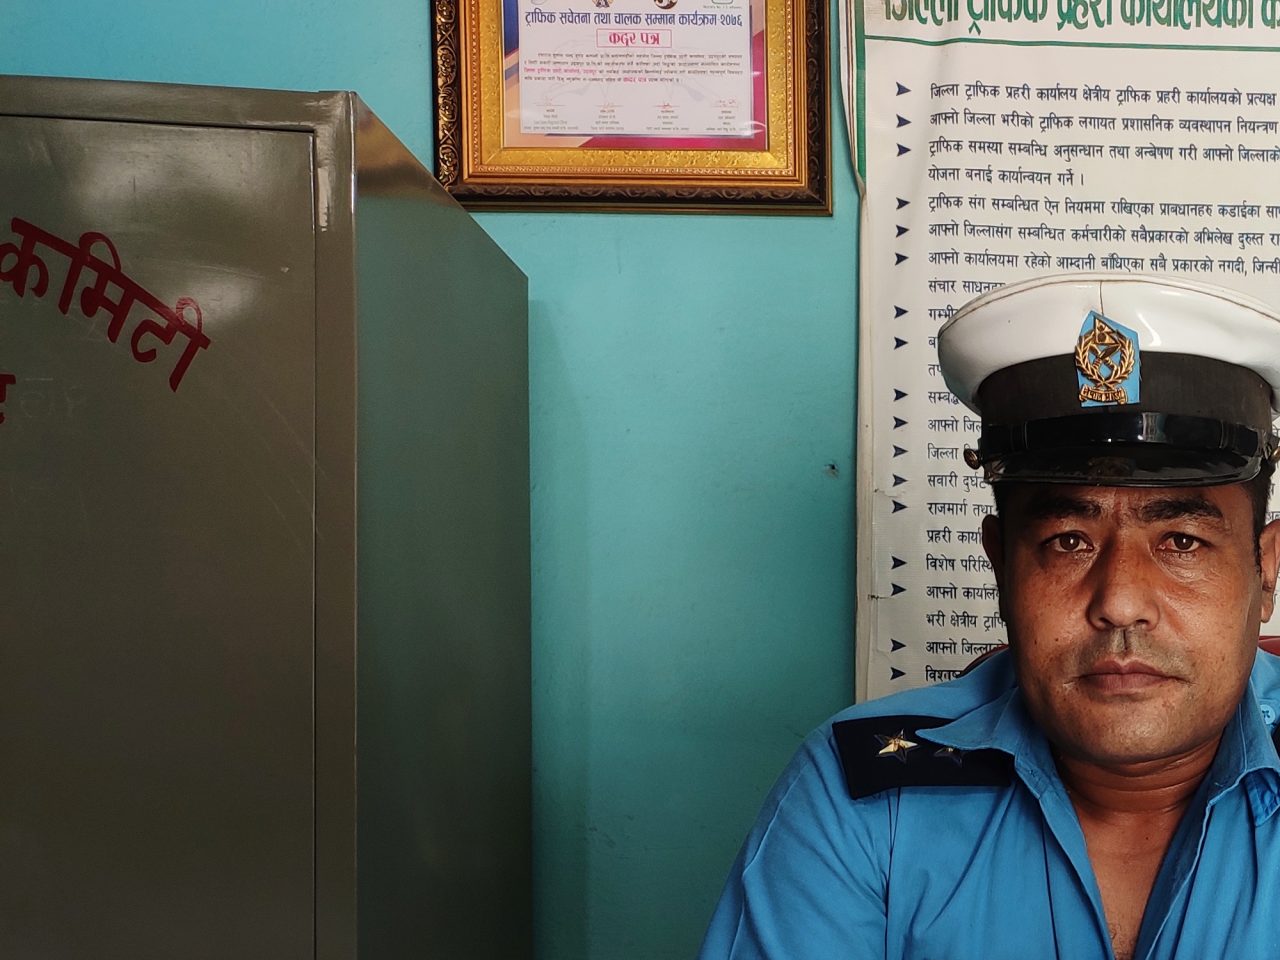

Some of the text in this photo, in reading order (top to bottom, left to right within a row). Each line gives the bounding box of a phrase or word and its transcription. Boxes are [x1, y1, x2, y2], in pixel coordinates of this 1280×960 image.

[525, 8, 675, 27] ट्राफिक सचेतना तथा चालक सम्मान
[930, 83, 959, 99] जिल्ला
[964, 80, 1000, 100] ट्राफिक
[1005, 83, 1031, 100] प्रहरी
[1036, 83, 1078, 101] कार्यालय
[1083, 84, 1111, 102] क्षेत्रीय
[1116, 85, 1151, 106] ट्राफिक
[1156, 87, 1181, 104] प्रहरी
[1186, 87, 1242, 105] कार्यालयको
[1246, 93, 1277, 106] प्रत्यक्ष
[930, 108, 960, 125] आफ्नो
[964, 108, 996, 126] जिल्ला
[1001, 110, 1034, 128] भरीको
[1039, 112, 1074, 133] ट्राफिक
[1079, 116, 1117, 130] लगायत
[1121, 114, 1174, 131] प्रशासनिक
[1179, 119, 1232, 133] व्यवस्थापन
[1237, 116, 1279, 134] नियन्त्रण
[929, 219, 960, 236] आफ्नो
[964, 219, 1013, 239] जिल्लासंग
[1018, 223, 1066, 241] सम्बन्धित
[1070, 224, 1127, 242] कर्मचारीको
[1194, 227, 1234, 245] अभिलेख
[928, 248, 959, 264] आफ्नो
[963, 249, 1019, 267] कार्यालयमा
[1023, 251, 1052, 269] रहेको
[1056, 253, 1096, 270] आम्दानी
[1149, 252, 1167, 271] सबै
[1172, 256, 1214, 272] प्रकारको
[1218, 257, 1247, 277] नगदी,
[0, 217, 211, 393] कमिटी
